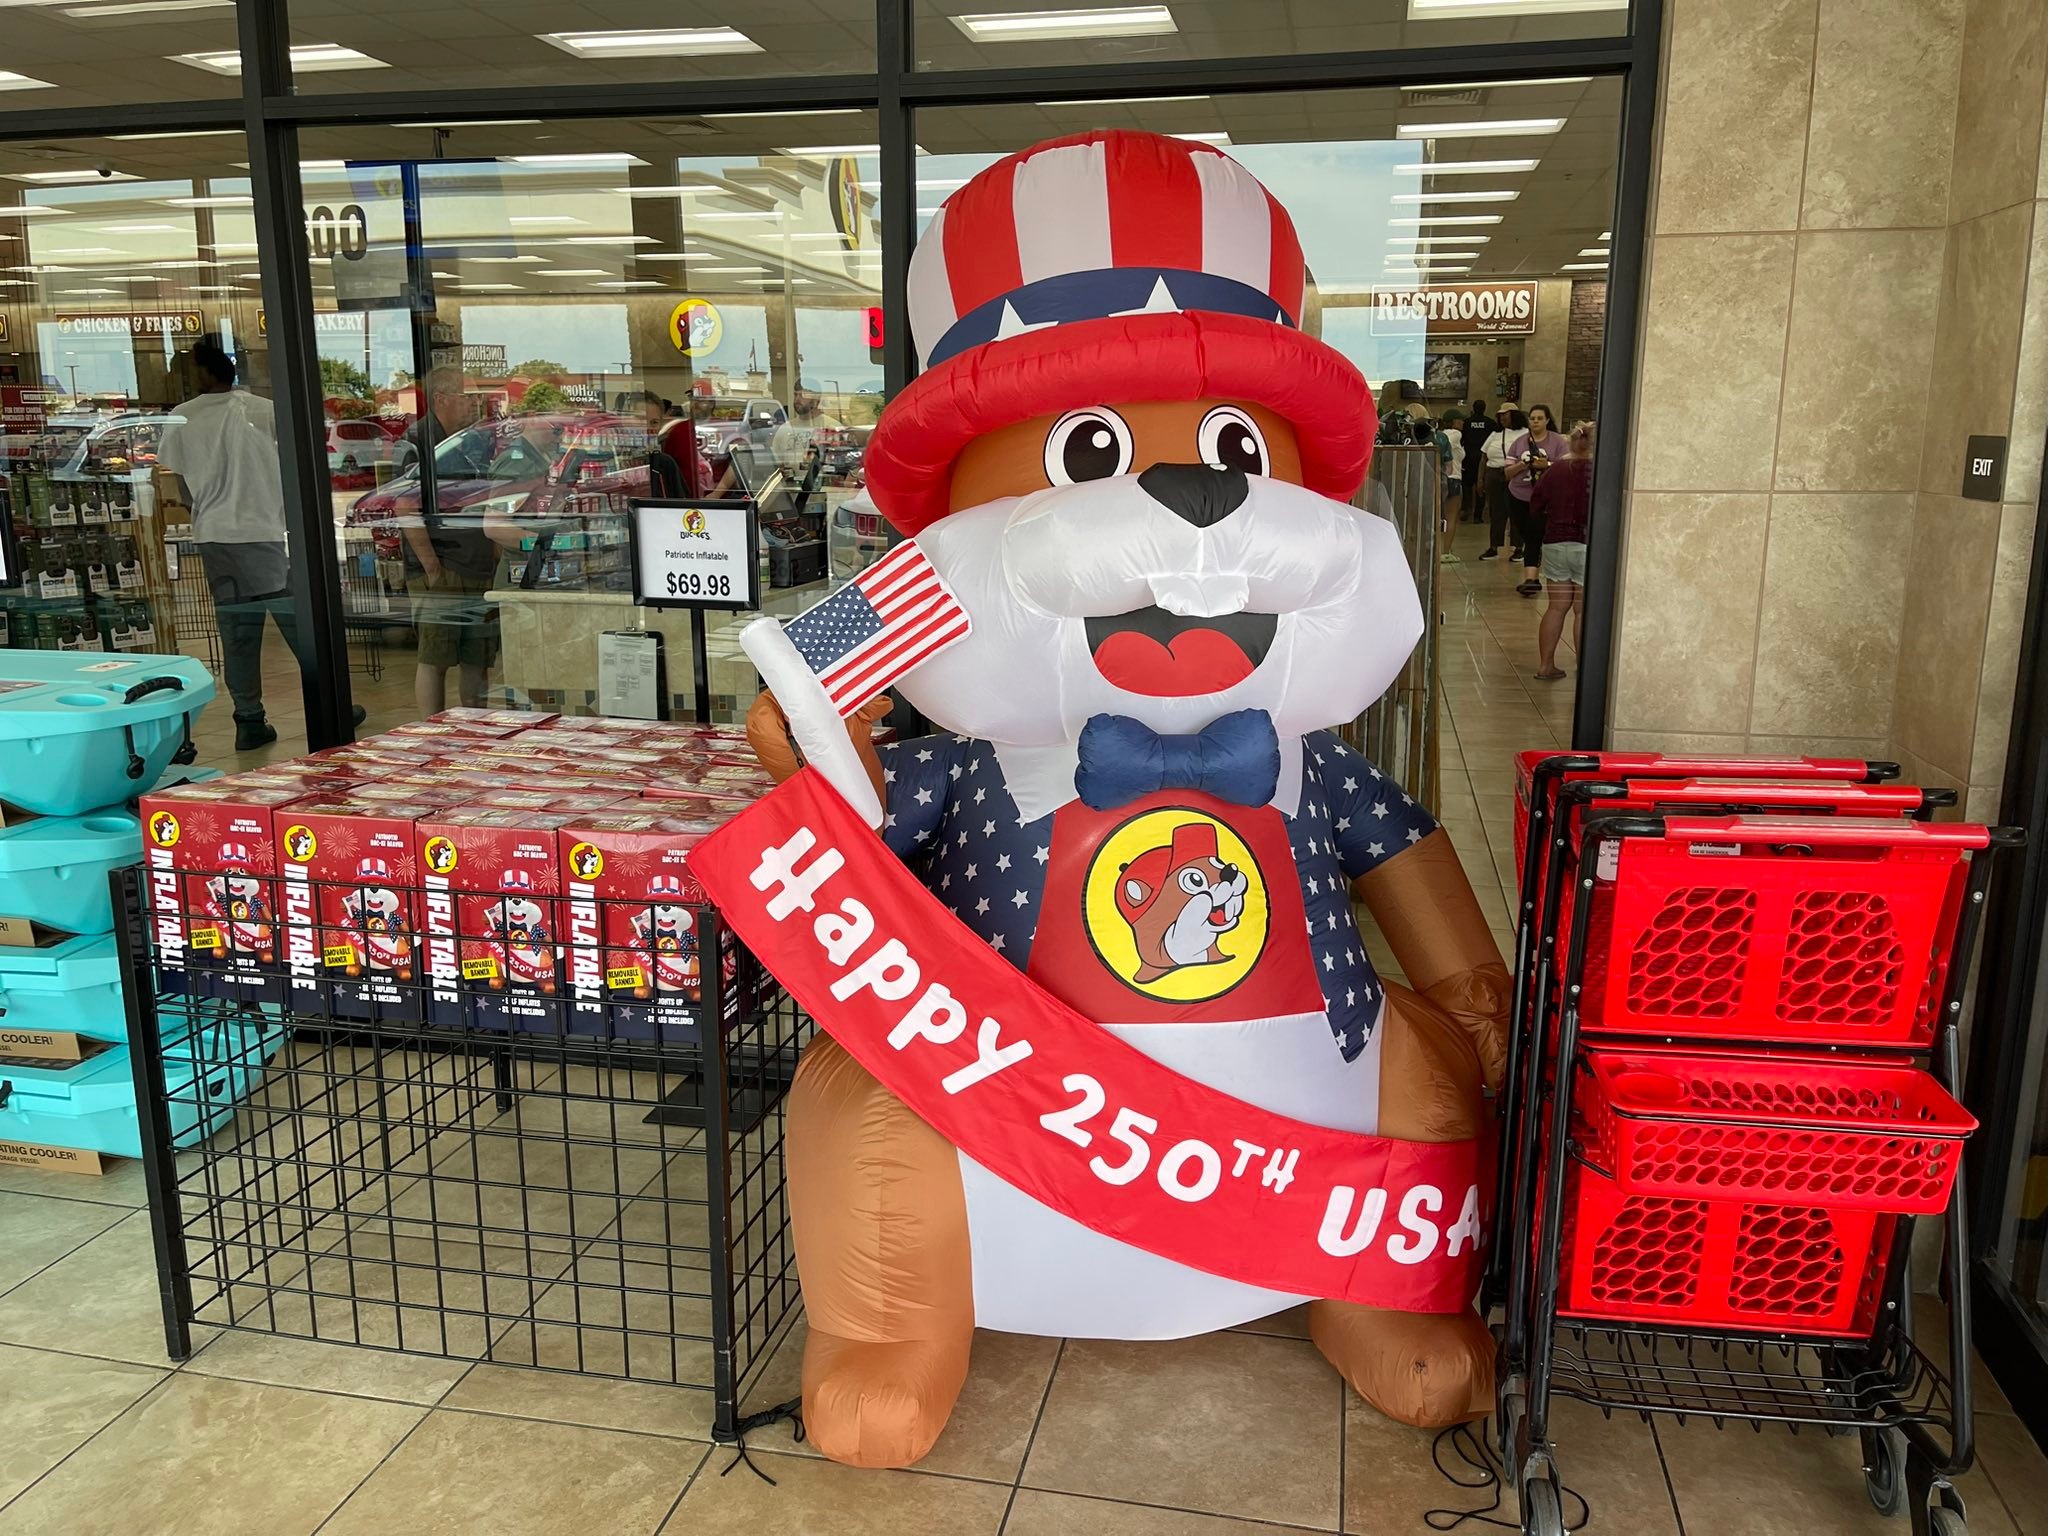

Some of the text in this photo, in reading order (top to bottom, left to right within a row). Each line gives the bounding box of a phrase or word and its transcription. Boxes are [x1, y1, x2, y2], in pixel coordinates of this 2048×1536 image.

[1377, 290, 1531, 321] RESTROOMS
[74, 315, 183, 334] CHICKEN & FRIES
[314, 314, 366, 332] AKERY
[1476, 322, 1529, 331] World Famous!
[1470, 422, 1485, 430] POLICE
[1972, 458, 1994, 476] EXIT
[665, 549, 729, 561] Patriotic Inflatable
[667, 571, 731, 596] $69.98
[150, 848, 185, 973] INFLATABLE
[284, 862, 317, 990] INFLATABLE
[196, 938, 214, 947] BANNER
[424, 874, 459, 1003] INFLATABLE
[569, 881, 602, 1014] INFLATABLE
[328, 955, 347, 965] BANNER
[463, 960, 494, 970] REMOVABLE
[469, 968, 490, 977] BANNER
[607, 969, 639, 979] REMOVABLE
[614, 978, 635, 987] BANNER
[749, 826, 1035, 1096] Happy
[1040, 1073, 1301, 1203] 250TH
[1, 1033, 53, 1045] COOLER!
[0, 1143, 78, 1161] ATING COOLER!
